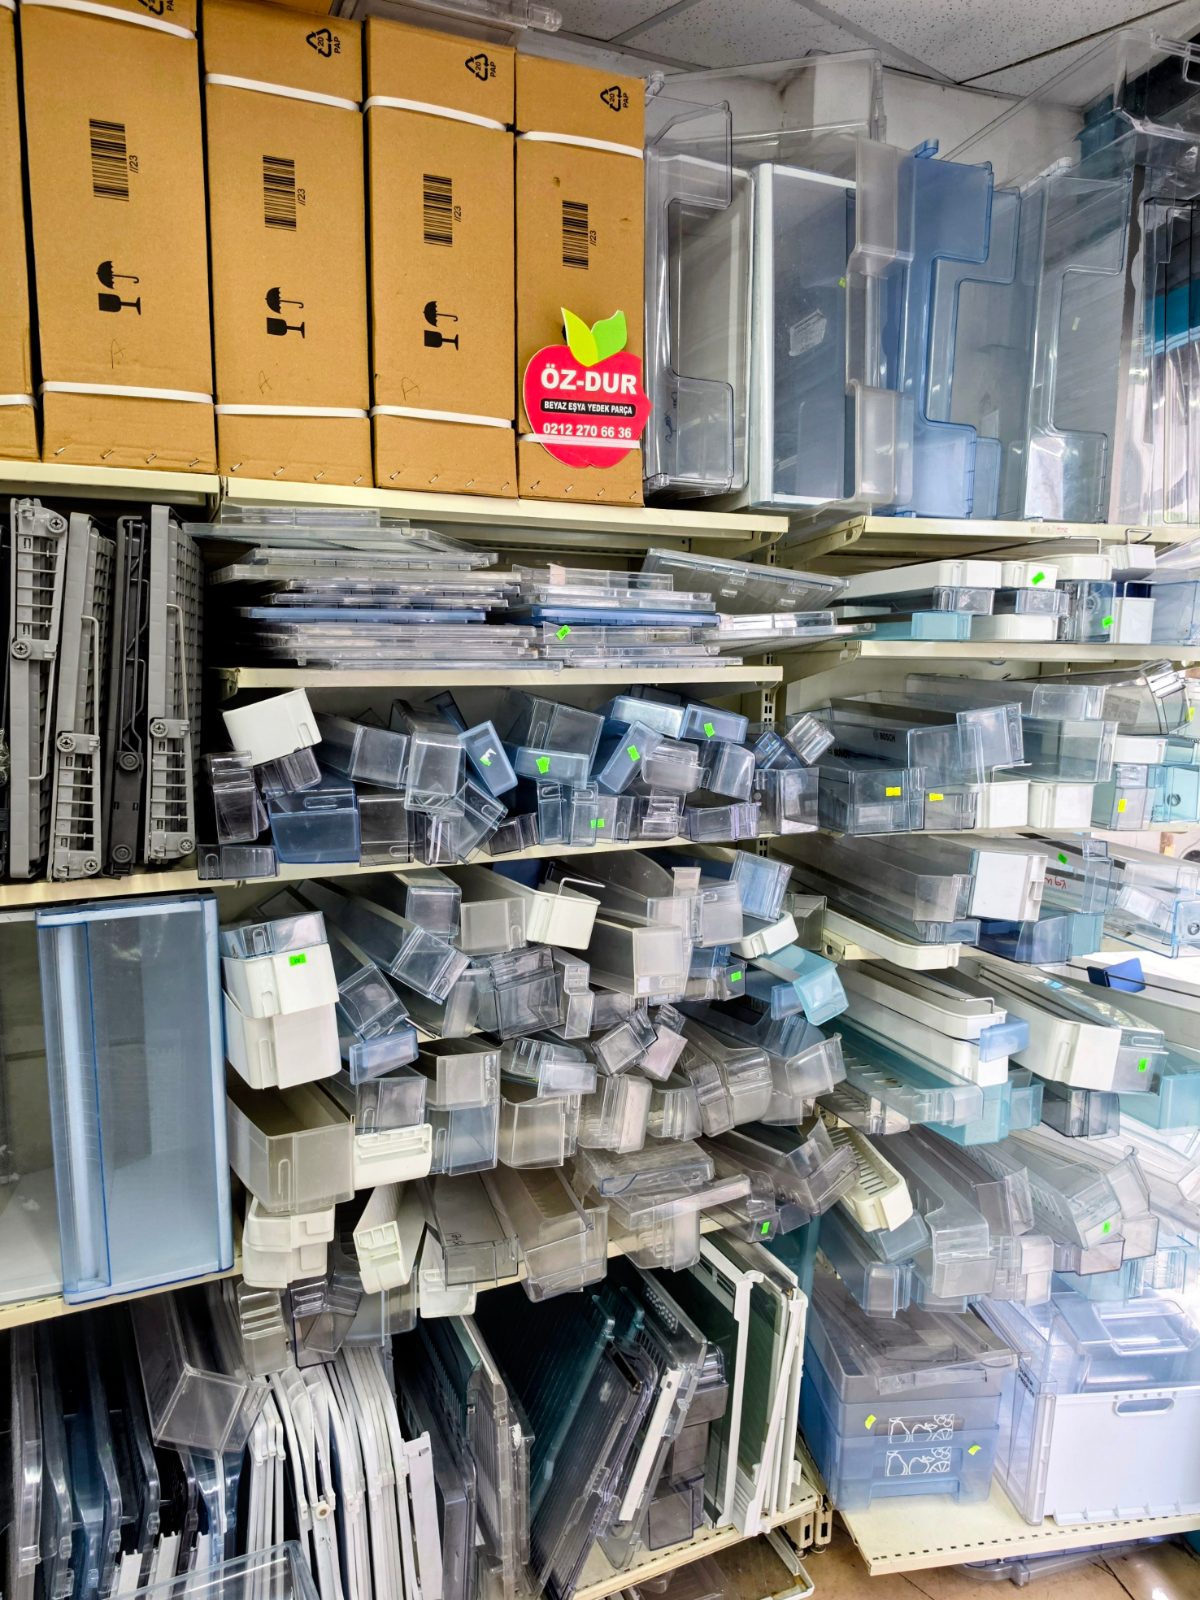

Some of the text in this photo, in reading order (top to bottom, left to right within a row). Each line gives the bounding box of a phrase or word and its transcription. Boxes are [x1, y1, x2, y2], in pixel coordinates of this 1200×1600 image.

[333, 36, 341, 54] PAP
[541, 363, 637, 394] ÖZ-DUR
[544, 401, 632, 415] BEYAZ EŞYA YEDEK PARÇA
[543, 423, 632, 439] 0212 270 66 36
